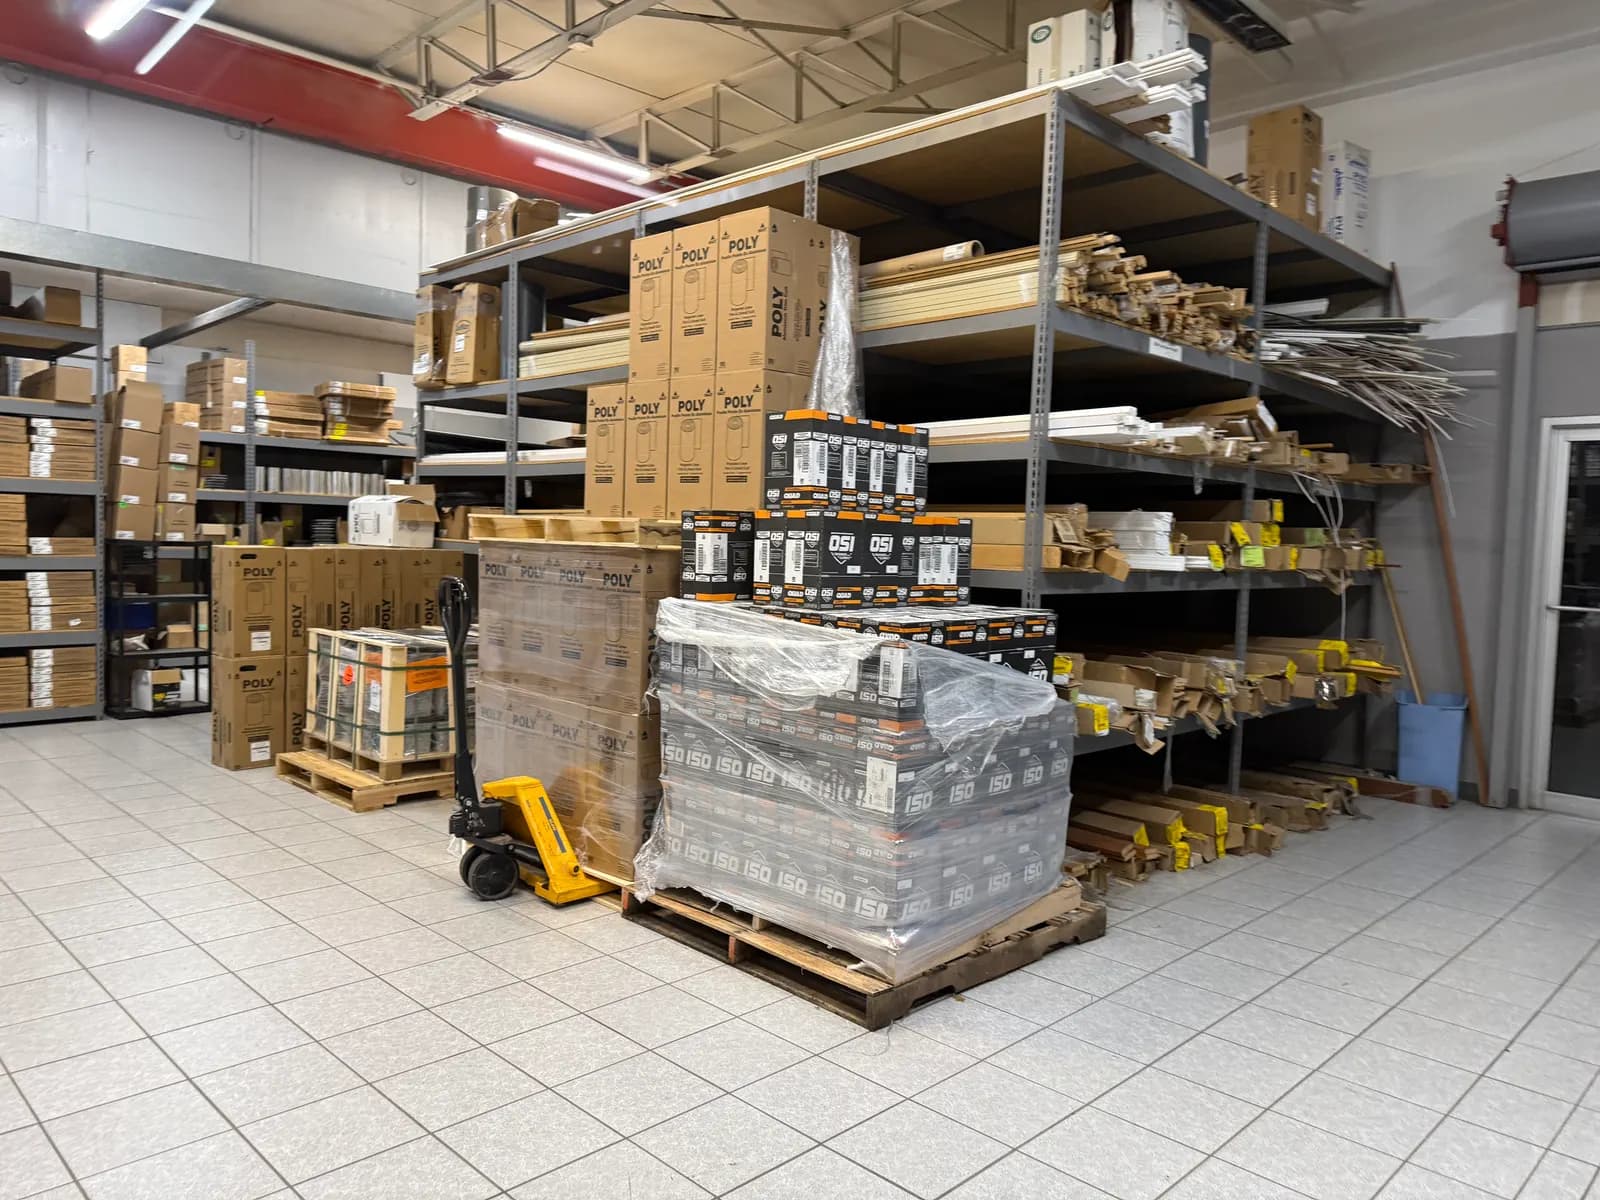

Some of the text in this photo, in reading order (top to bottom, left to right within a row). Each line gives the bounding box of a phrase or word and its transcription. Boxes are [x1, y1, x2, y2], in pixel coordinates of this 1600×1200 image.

[729, 235, 759, 253] POLY
[682, 246, 710, 264] POLY
[638, 256, 664, 273] POLY
[772, 286, 785, 338] POLY
[634, 402, 660, 415] POLY
[678, 399, 705, 412] POLY
[724, 394, 754, 409] POLY
[594, 406, 618, 418] POLY
[770, 532, 784, 541] OSI
[805, 532, 820, 541] OSI
[828, 534, 856, 553] OSI
[869, 536, 894, 553] OSI
[243, 567, 276, 577] POLY
[485, 563, 507, 577] POLY
[560, 569, 586, 584] POLY
[602, 572, 633, 588] POLY
[291, 603, 303, 638] POLY
[242, 677, 275, 689] POLY
[291, 711, 304, 746] POLY
[512, 714, 537, 729] POLY
[552, 723, 580, 741] POLY
[597, 734, 628, 752] POLY
